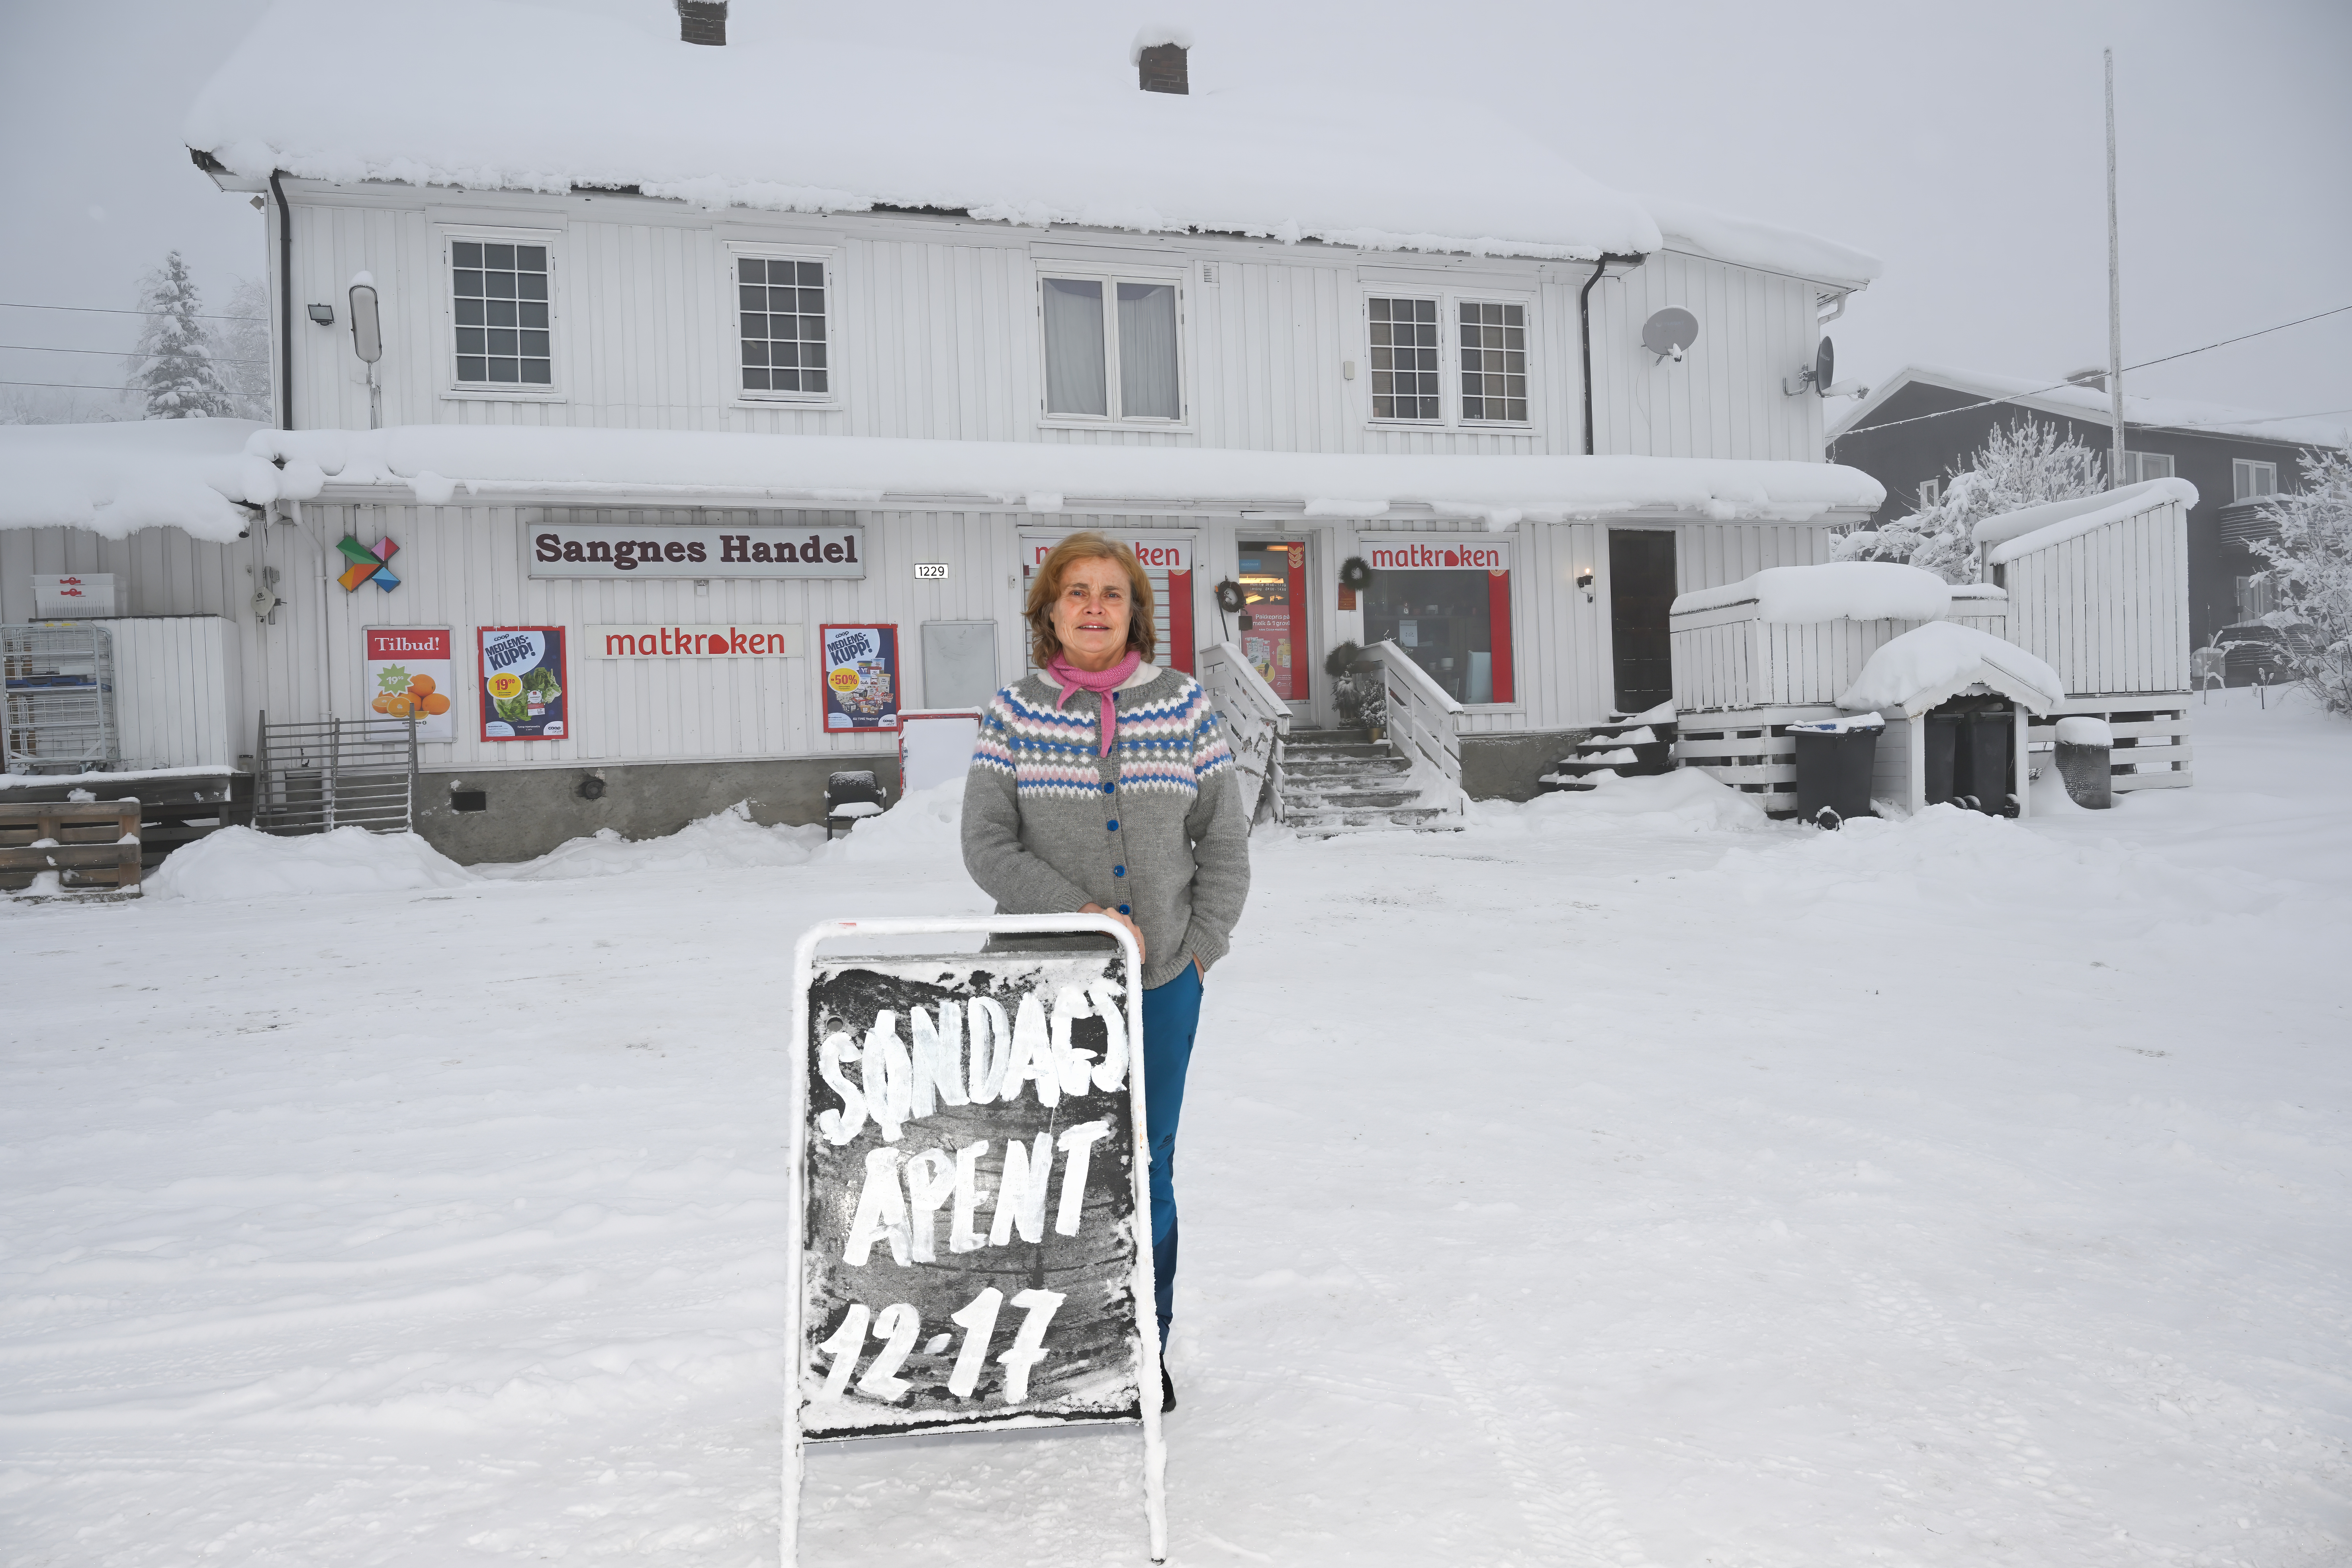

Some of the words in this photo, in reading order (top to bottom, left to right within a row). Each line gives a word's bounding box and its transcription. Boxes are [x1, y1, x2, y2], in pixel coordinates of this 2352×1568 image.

[535, 533, 707, 570] Sangnes
[720, 534, 858, 563] Handel
[919, 566, 944, 576] 1229
[375, 637, 439, 651] Tilbud!
[485, 635, 528, 657] MEDLEMS-
[827, 632, 866, 652] MEDLEMS-
[830, 639, 873, 666] KUPP!
[489, 642, 536, 671] KUPP!
[831, 675, 857, 685] -50%
[818, 985, 1129, 1146] SØNDAGS
[819, 1287, 1067, 1404] 12-17
